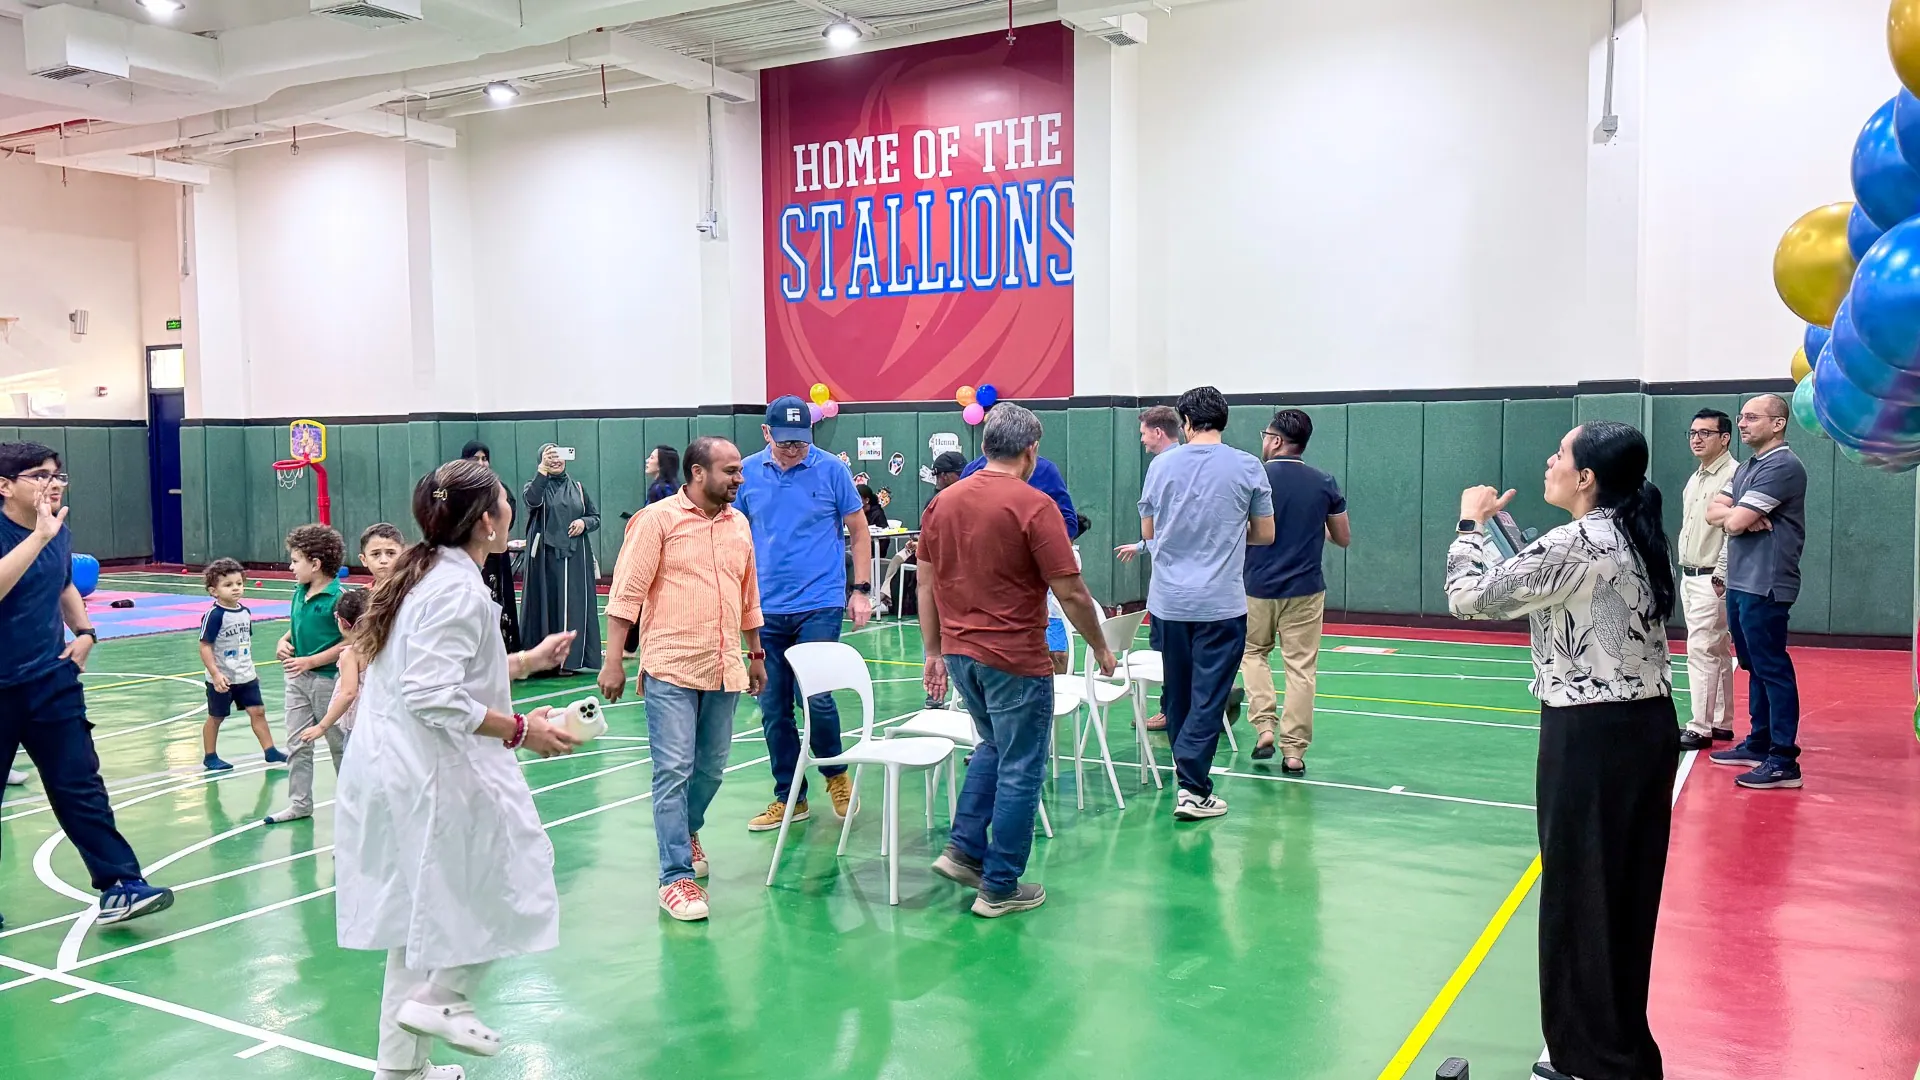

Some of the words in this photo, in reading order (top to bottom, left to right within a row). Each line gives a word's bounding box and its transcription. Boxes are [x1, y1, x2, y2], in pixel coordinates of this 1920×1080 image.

[793, 133, 899, 192] HOME
[913, 126, 960, 180] OF
[975, 112, 1062, 173] THE
[780, 177, 1074, 301] STALLIONS
[225, 629, 239, 638] ALL
